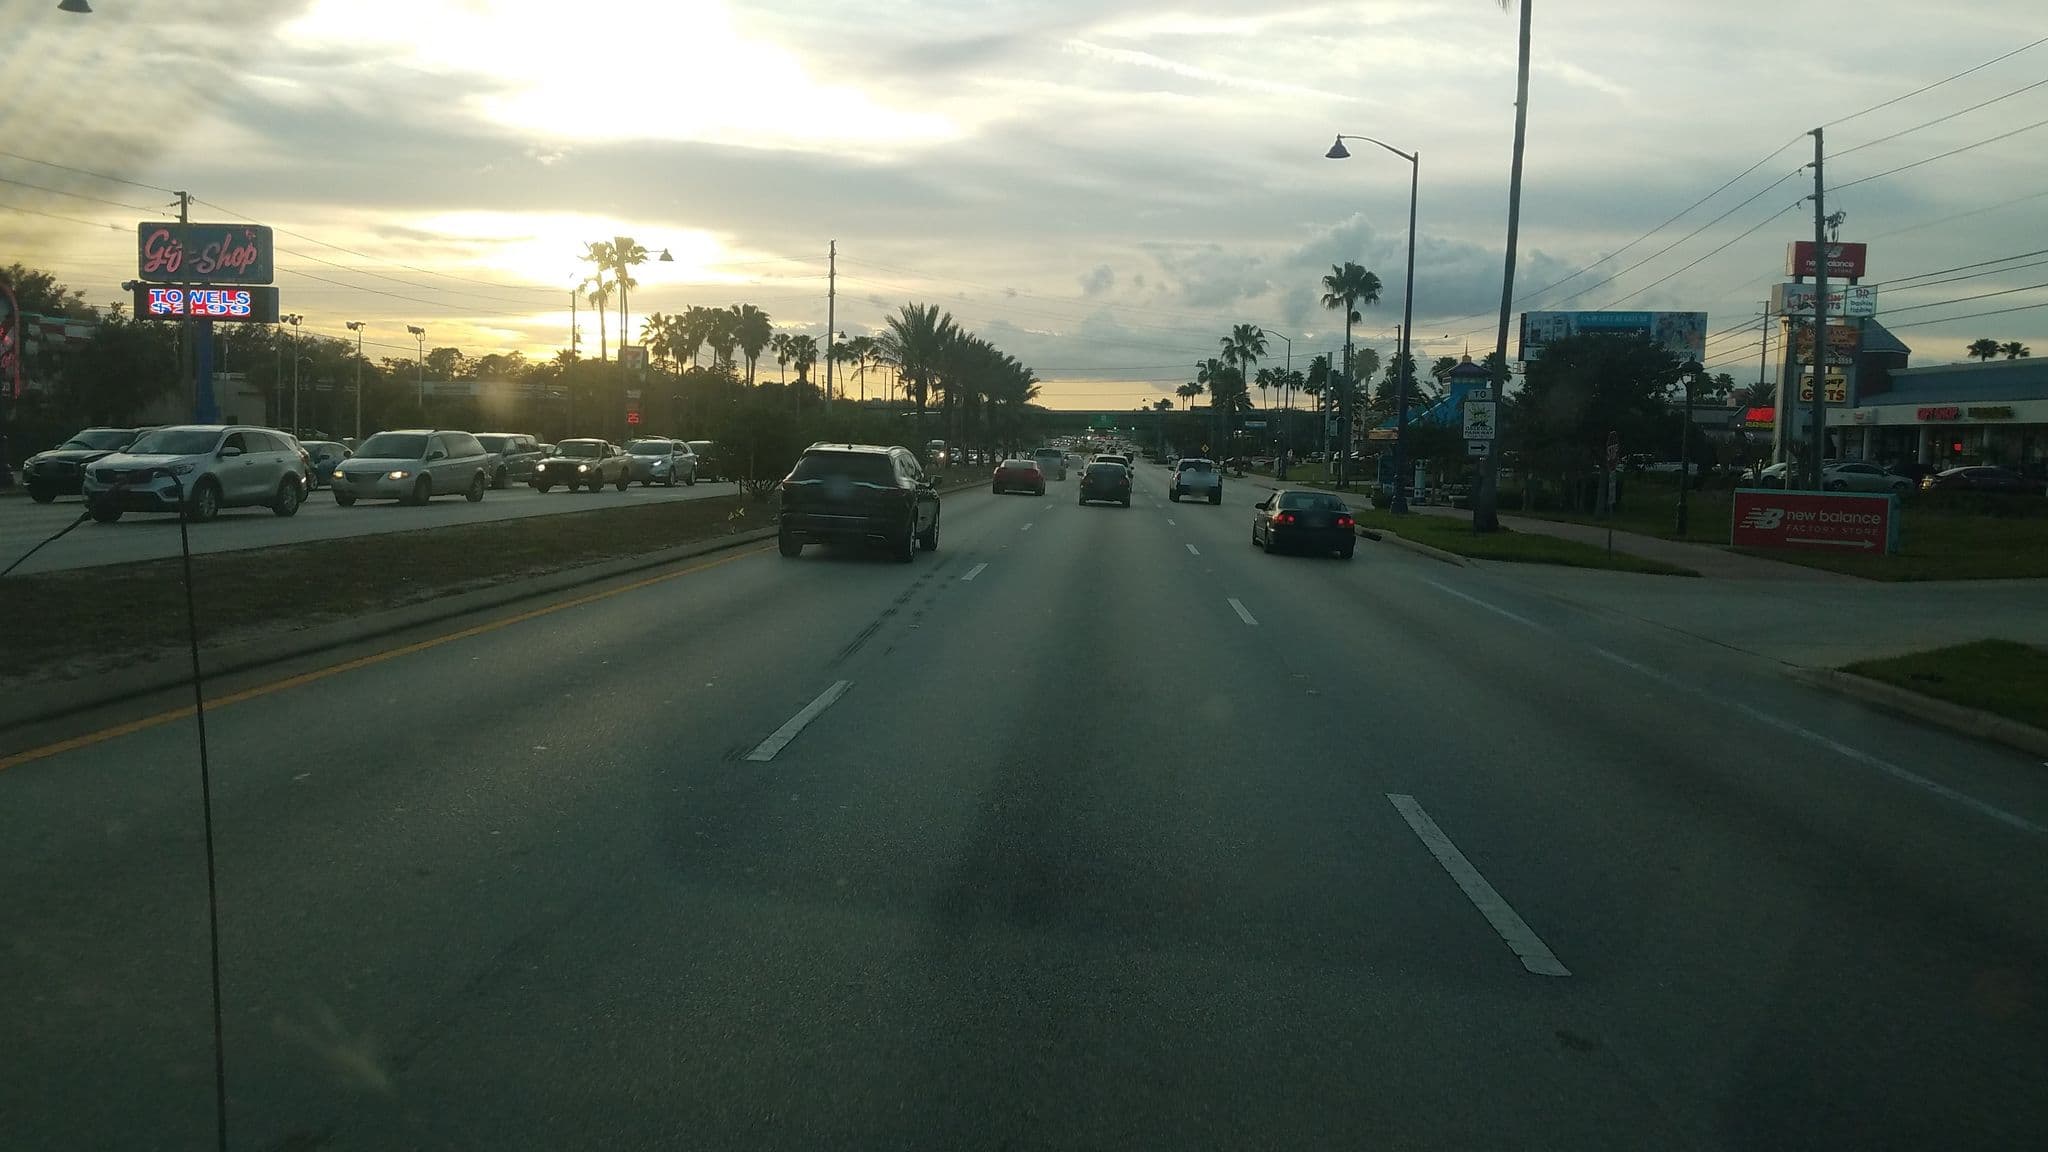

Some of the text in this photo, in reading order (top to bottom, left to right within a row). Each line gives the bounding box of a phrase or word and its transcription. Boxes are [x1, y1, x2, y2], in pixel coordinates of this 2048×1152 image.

[144, 229, 257, 274] Gif Shop
[1826, 259, 1854, 267] alance
[150, 289, 250, 305] TOWELS
[1473, 390, 1487, 399] TO
[1801, 389, 1844, 401] GTS
[1786, 509, 1881, 525] new balance
[1786, 524, 1880, 537] FACTORY STORE
